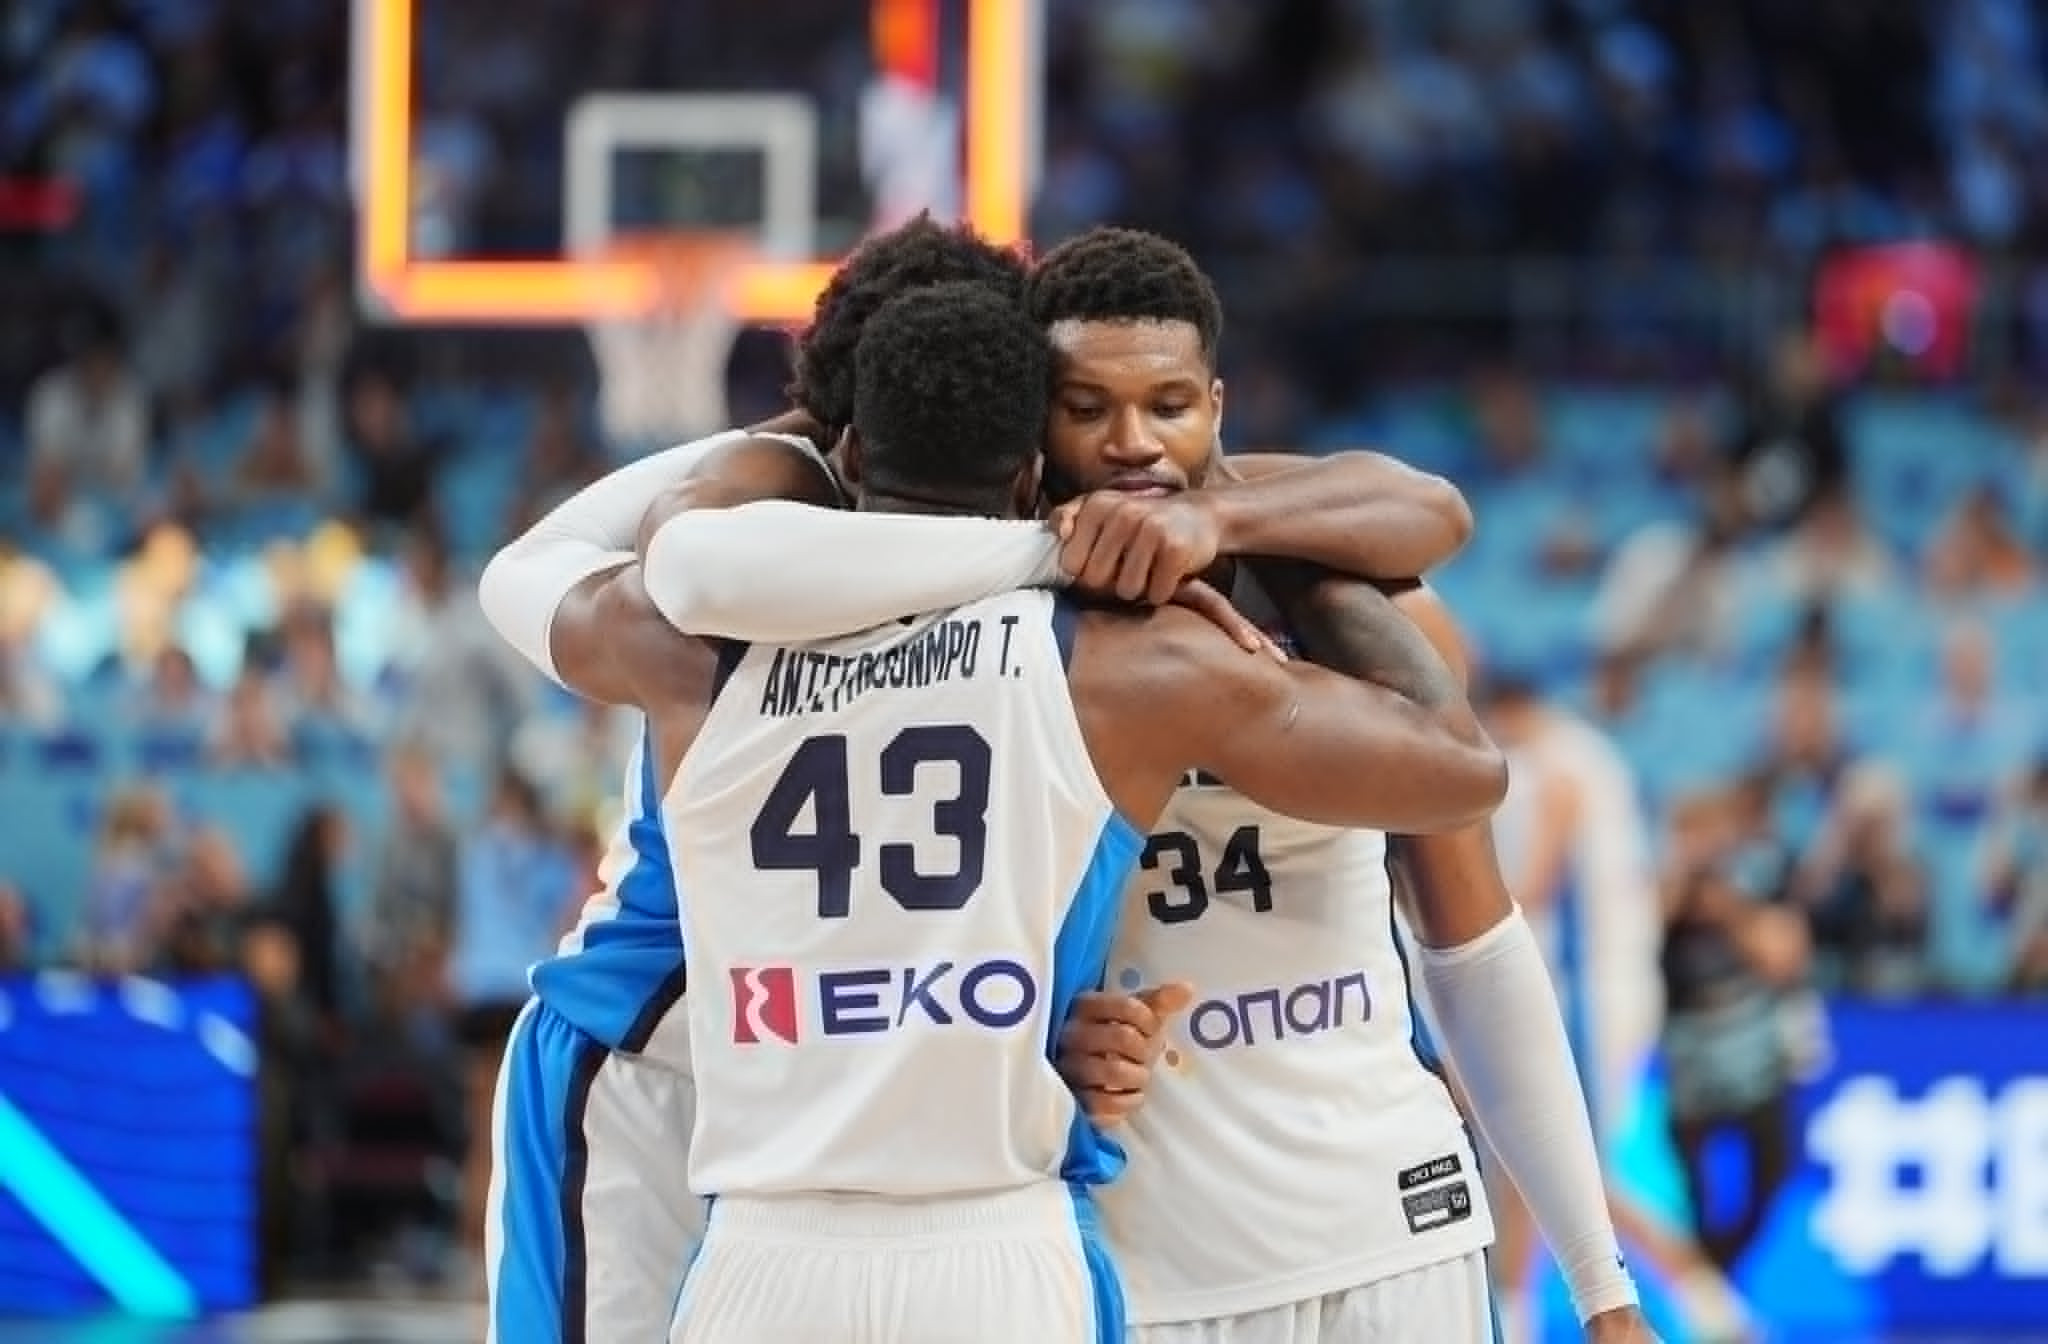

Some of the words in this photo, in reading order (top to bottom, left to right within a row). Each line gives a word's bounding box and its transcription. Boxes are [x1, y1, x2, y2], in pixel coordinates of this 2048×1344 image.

[1000, 615, 1022, 679] T.
[750, 724, 992, 919] 43
[1140, 824, 1273, 924] 34
[818, 959, 1037, 1036] EKO
